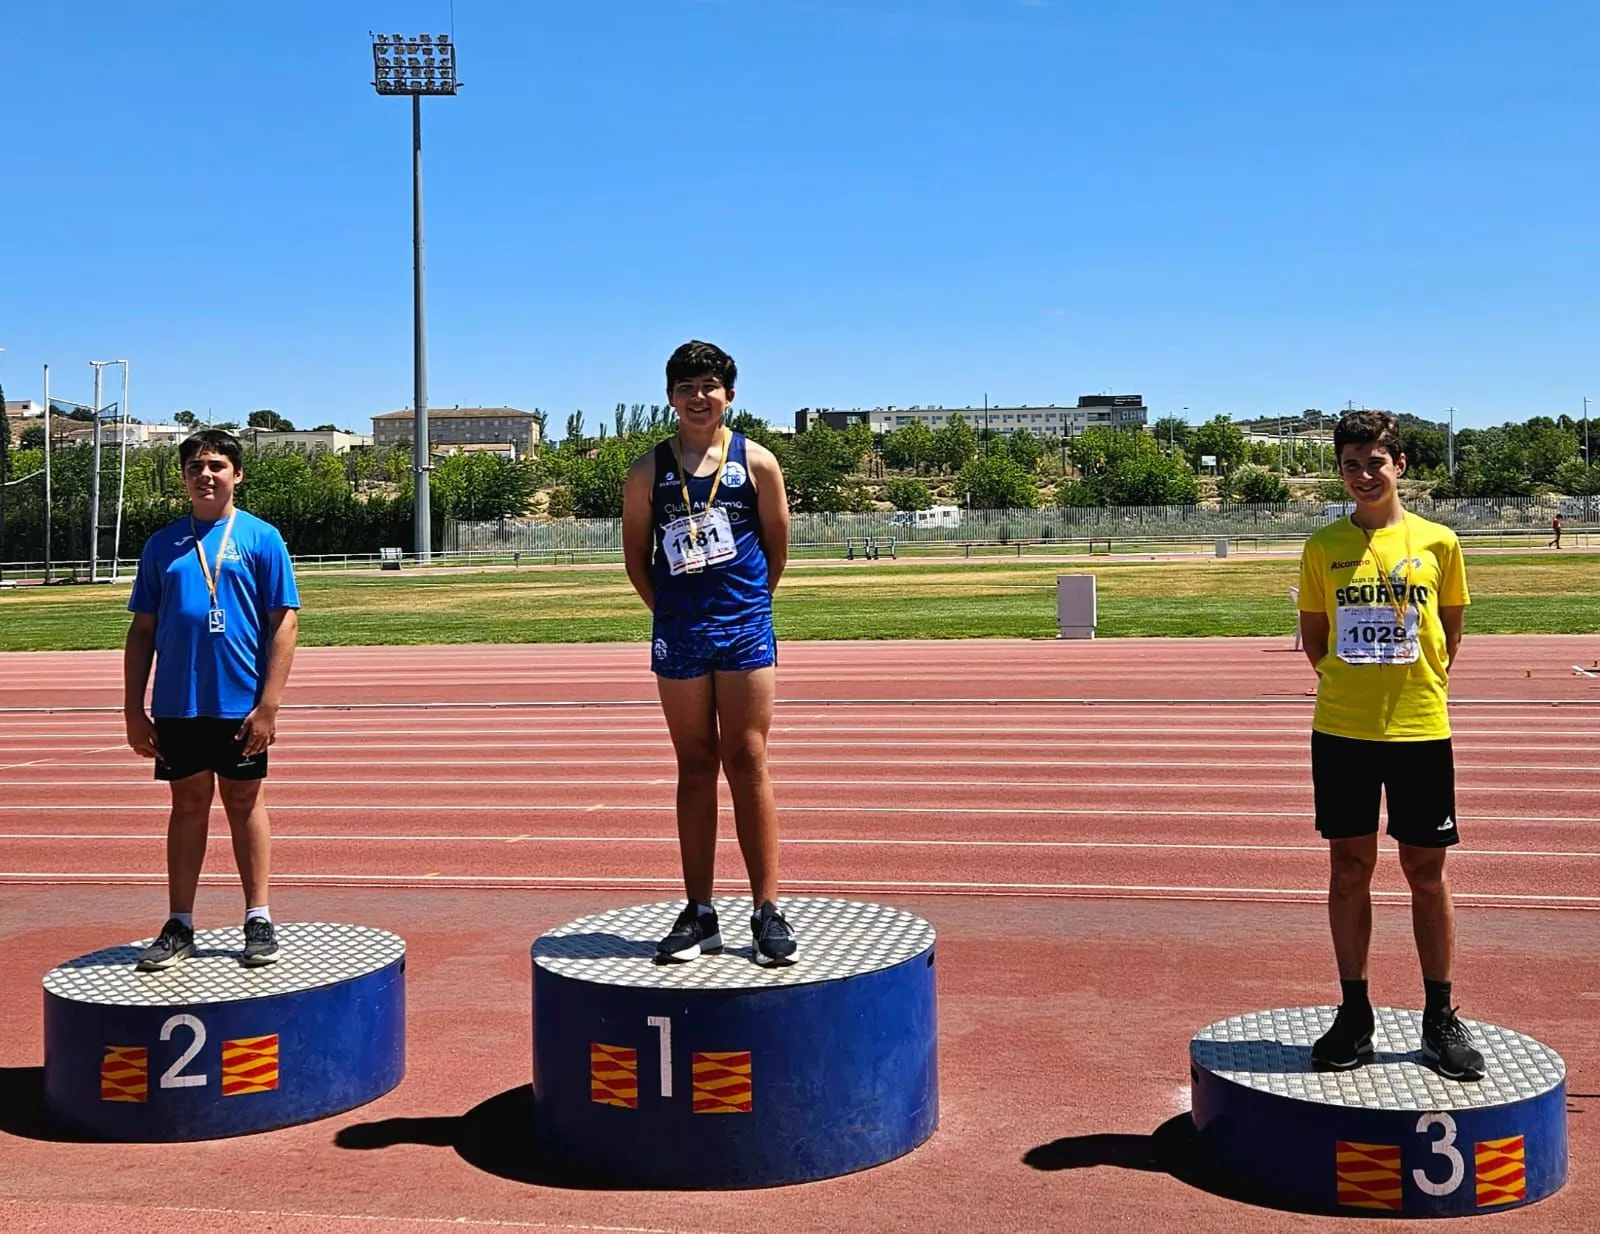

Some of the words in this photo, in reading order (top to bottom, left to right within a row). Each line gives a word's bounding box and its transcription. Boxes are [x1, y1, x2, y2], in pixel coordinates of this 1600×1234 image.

[664, 502, 688, 514] Club
[672, 527, 720, 554] 1181
[1331, 559, 1370, 572] Alcampo
[1336, 584, 1428, 606] SCORPIO
[1348, 626, 1407, 643] 1029
[160, 1013, 207, 1088] 2
[647, 1016, 672, 1097] 1
[1412, 1111, 1465, 1196] 3
